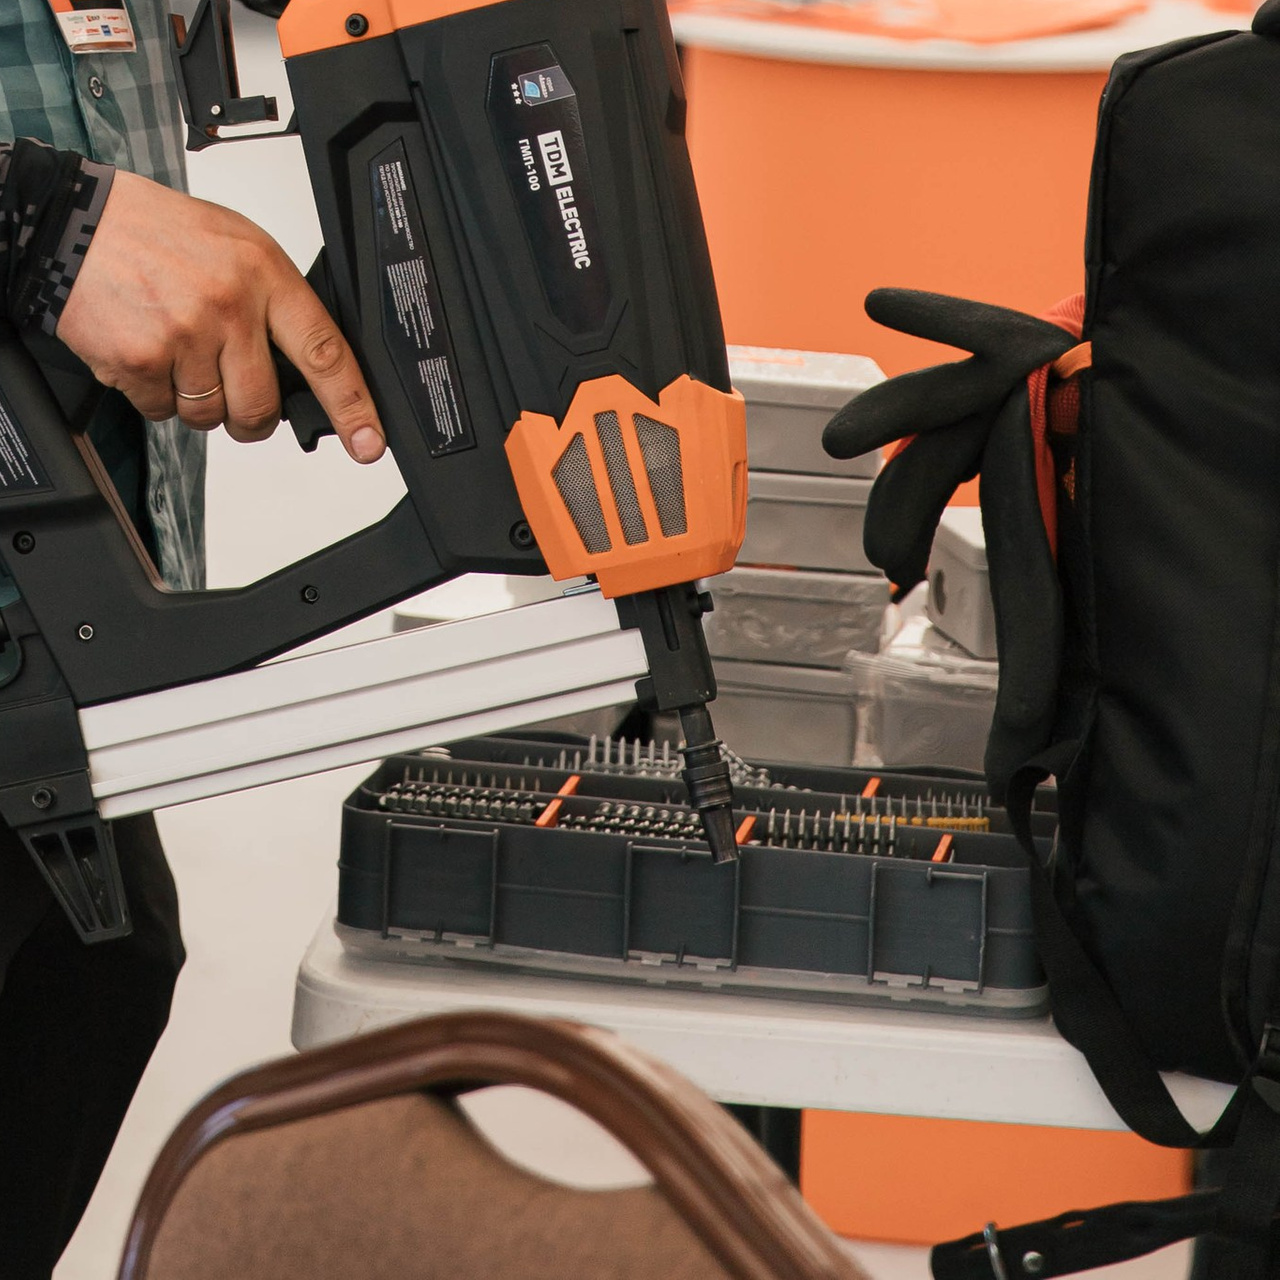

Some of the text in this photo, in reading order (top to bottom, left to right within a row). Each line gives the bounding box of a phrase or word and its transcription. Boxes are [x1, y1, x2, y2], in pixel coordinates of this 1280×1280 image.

[518, 138, 540, 191] ГМП-100
[543, 137, 591, 270] TDM ELECTRIC
